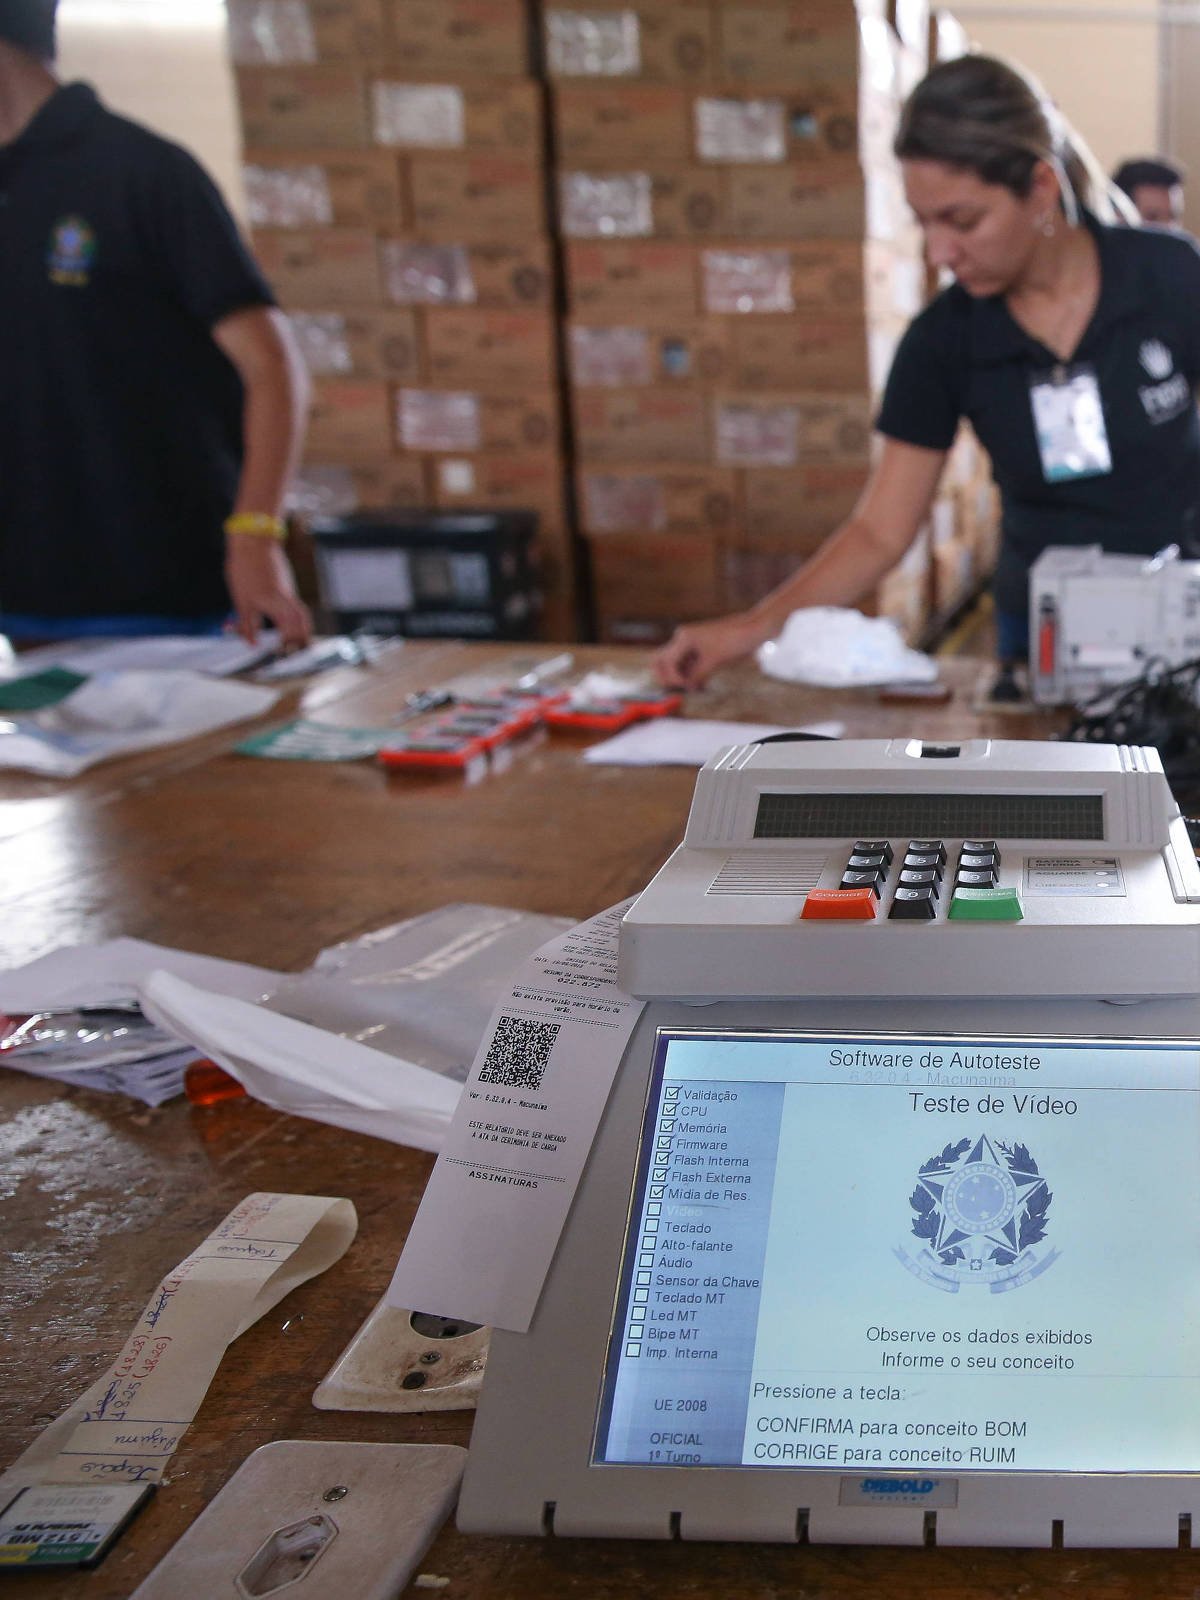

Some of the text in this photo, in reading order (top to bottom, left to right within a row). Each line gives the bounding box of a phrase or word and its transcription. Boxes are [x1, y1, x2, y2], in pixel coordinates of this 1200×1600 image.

[829, 1049, 1041, 1071] Software de Autoteste
[684, 1089, 738, 1103] Validação
[909, 1092, 1078, 1116] Teste de Vídeo
[681, 1106, 708, 1117] CPU
[468, 1120, 484, 1129] ESTE
[516, 1128, 530, 1138] DEVE
[532, 1131, 543, 1139] SER
[544, 1134, 567, 1143] ANEXADO
[678, 1122, 728, 1134] Memória
[478, 1133, 489, 1141] ATA
[540, 1143, 558, 1152] CARGA
[676, 1139, 728, 1151] Firmware
[674, 1155, 750, 1167] Flash Interna
[468, 1170, 540, 1190] ASSINATURAS
[671, 1171, 751, 1185] Flash Externa
[668, 1188, 751, 1201] Mídia de Res.
[665, 1221, 712, 1234] Teclado
[660, 1239, 733, 1252] Alto-falante
[658, 1254, 693, 1269] Áudio
[655, 1275, 760, 1288] Sensor da Chave
[655, 1291, 726, 1304] Teclado MT
[650, 1310, 698, 1321] Led MT
[648, 1328, 700, 1342] Bipe MT
[866, 1327, 1093, 1346] Observe os dados exibidos
[646, 1346, 719, 1361] Imp. Interna
[881, 1352, 1075, 1370] Informe o seu conceito
[753, 1383, 837, 1400] Pressione
[842, 1388, 854, 1401] a
[654, 1399, 708, 1413] UE 2008
[756, 1416, 1027, 1439] CONFIRMA para conceito BOM
[650, 1432, 703, 1446] OFICIAL
[665, 1451, 701, 1464] Turno
[753, 1443, 1016, 1465] CORRIGE para conceito RUIM
